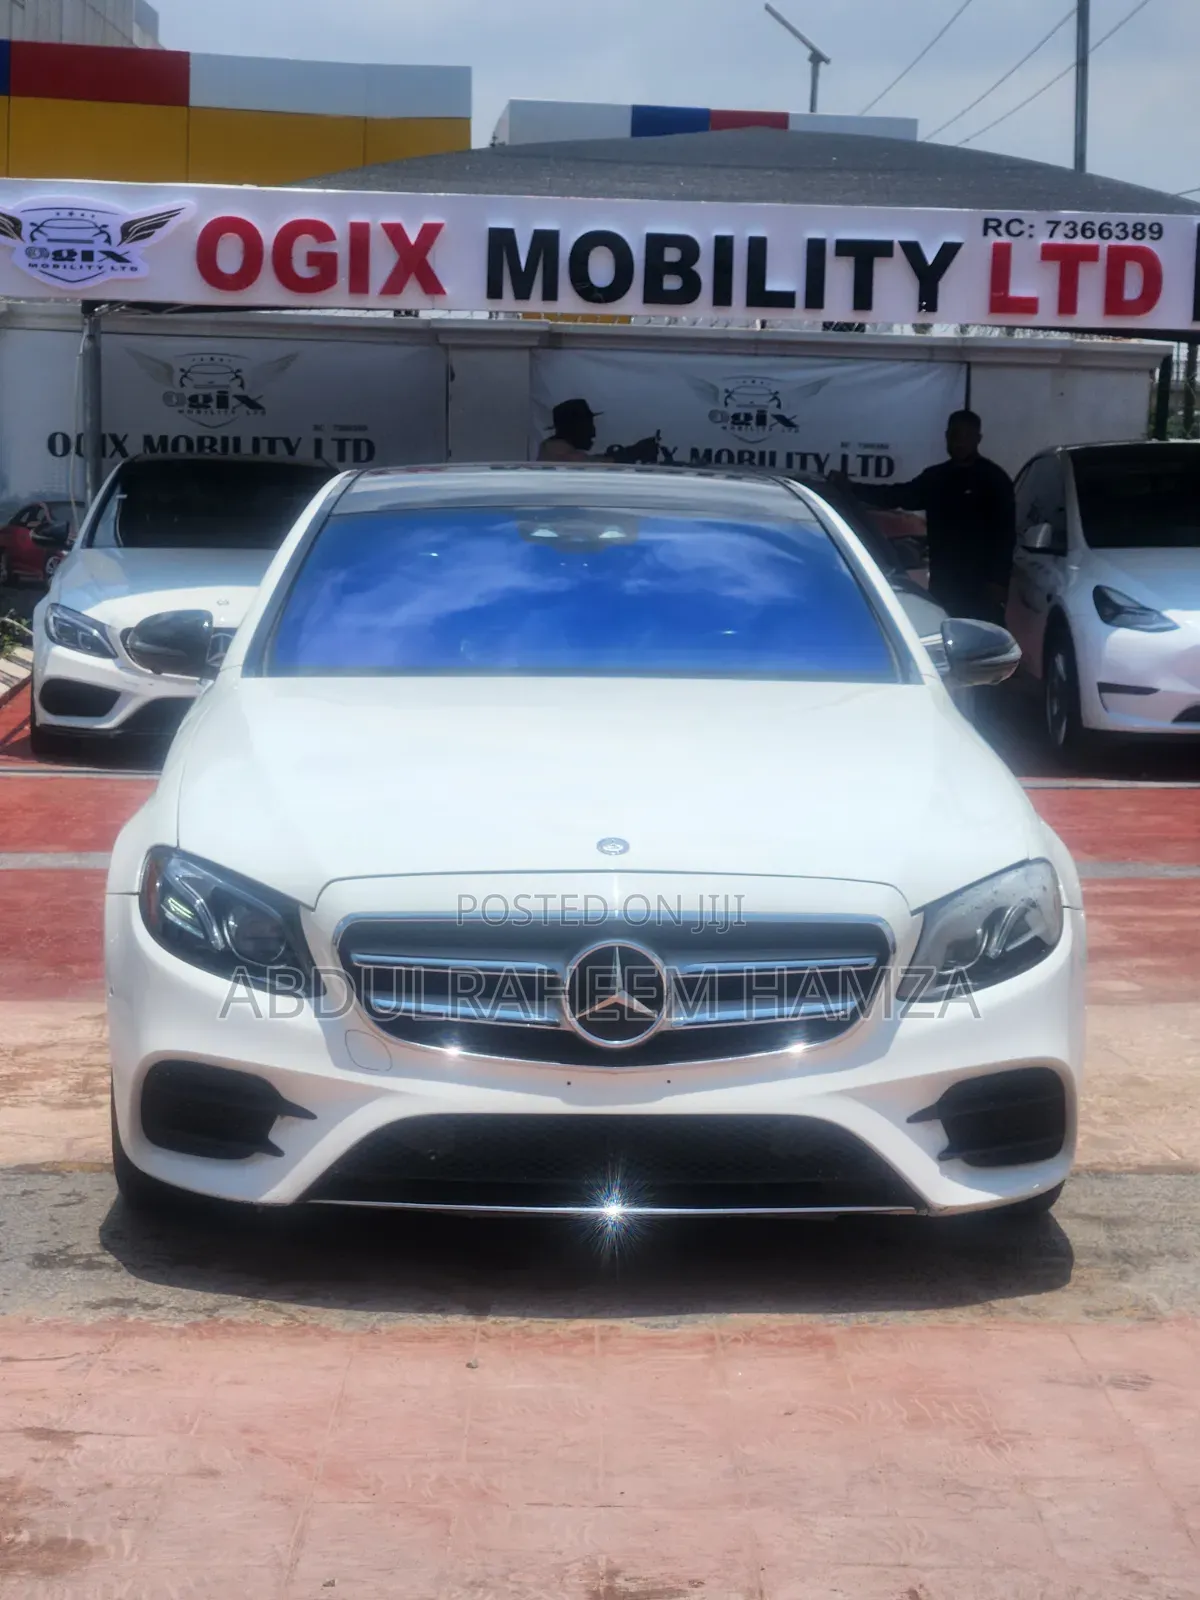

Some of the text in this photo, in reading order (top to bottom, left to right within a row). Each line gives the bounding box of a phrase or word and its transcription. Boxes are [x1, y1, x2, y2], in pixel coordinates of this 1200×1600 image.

[982, 217, 1163, 241] RC: 7366389
[28, 263, 103, 271] MOBILITY
[196, 215, 447, 297] OGIX
[486, 226, 964, 313] MOBILITY
[988, 242, 1163, 317] LTD
